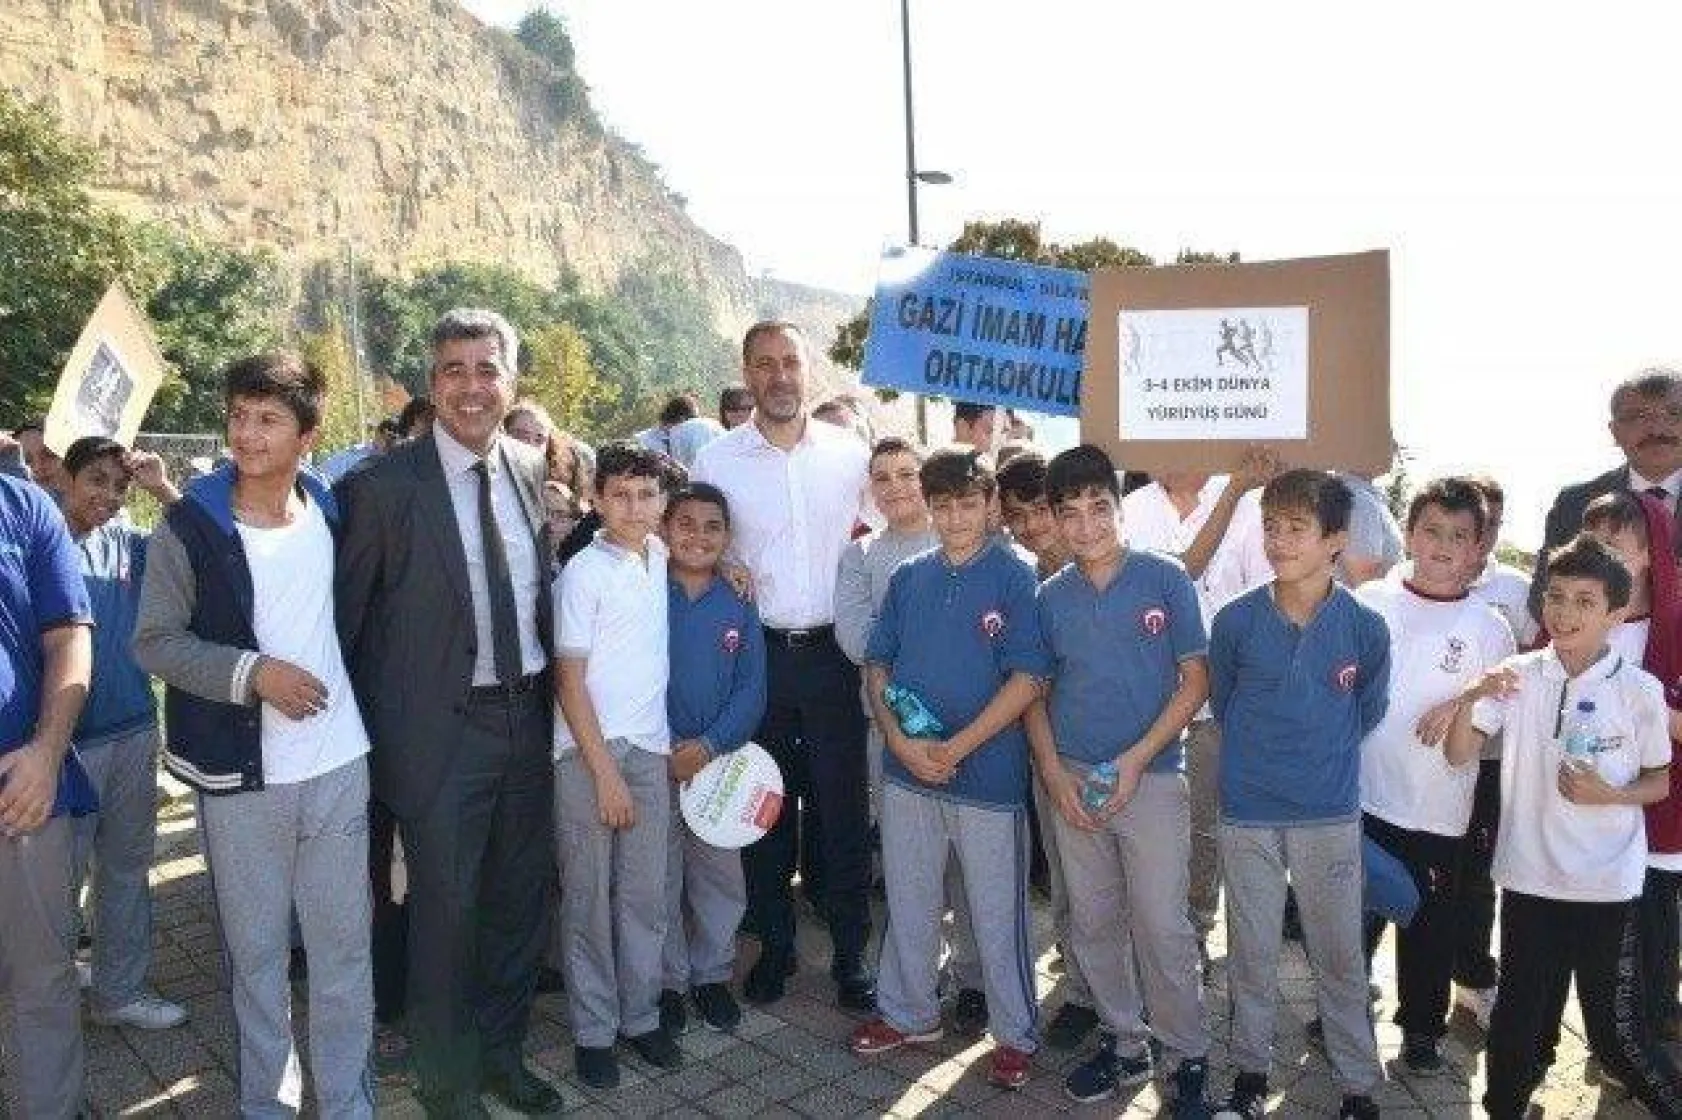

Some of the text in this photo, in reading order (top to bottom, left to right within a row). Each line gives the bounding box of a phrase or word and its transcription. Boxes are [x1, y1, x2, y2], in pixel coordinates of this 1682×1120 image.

[899, 291, 966, 337] GAZİ
[972, 294, 1047, 350] İMAM
[1142, 373, 1271, 393] 3-4 EKİM DÜNYA
[1223, 402, 1268, 420] GÜNÜ
